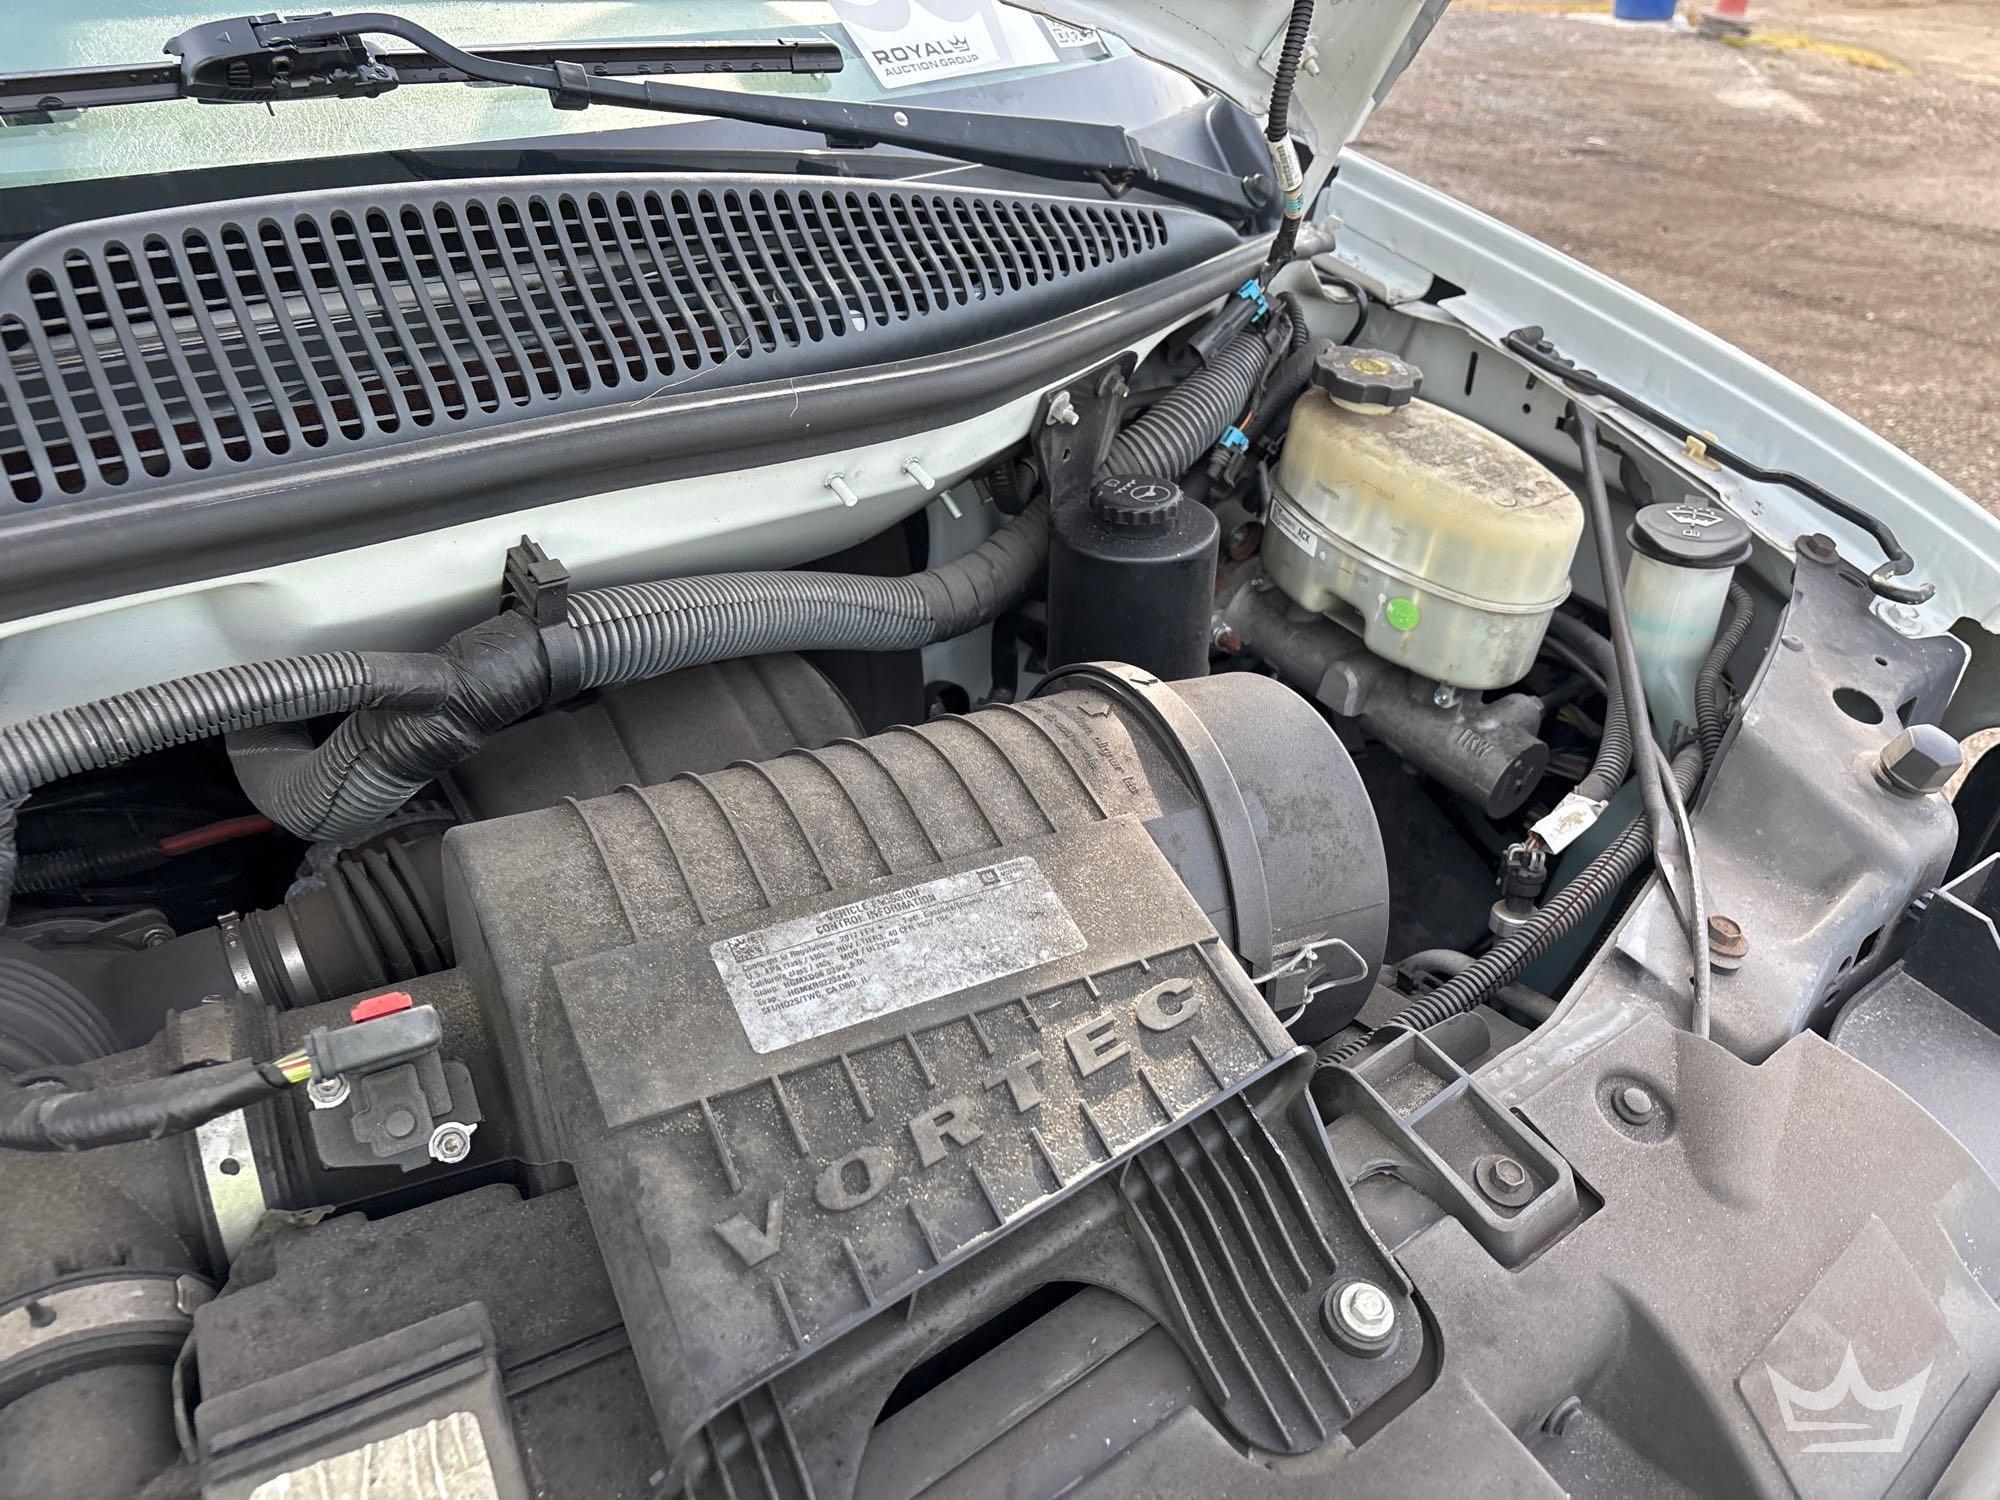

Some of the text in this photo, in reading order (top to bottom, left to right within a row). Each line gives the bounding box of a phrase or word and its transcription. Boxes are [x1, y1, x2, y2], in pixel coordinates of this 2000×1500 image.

[872, 41, 953, 64] ROYAL
[885, 54, 979, 76] AUCTION GROUP
[1457, 729, 1494, 758] TRW
[816, 894, 937, 934] CONTROL INFORMATION
[825, 889, 920, 920] VEHICLE EMISSION
[750, 972, 787, 989] California
[826, 987, 837, 995] CA
[713, 977, 1201, 1267] VORTEC
